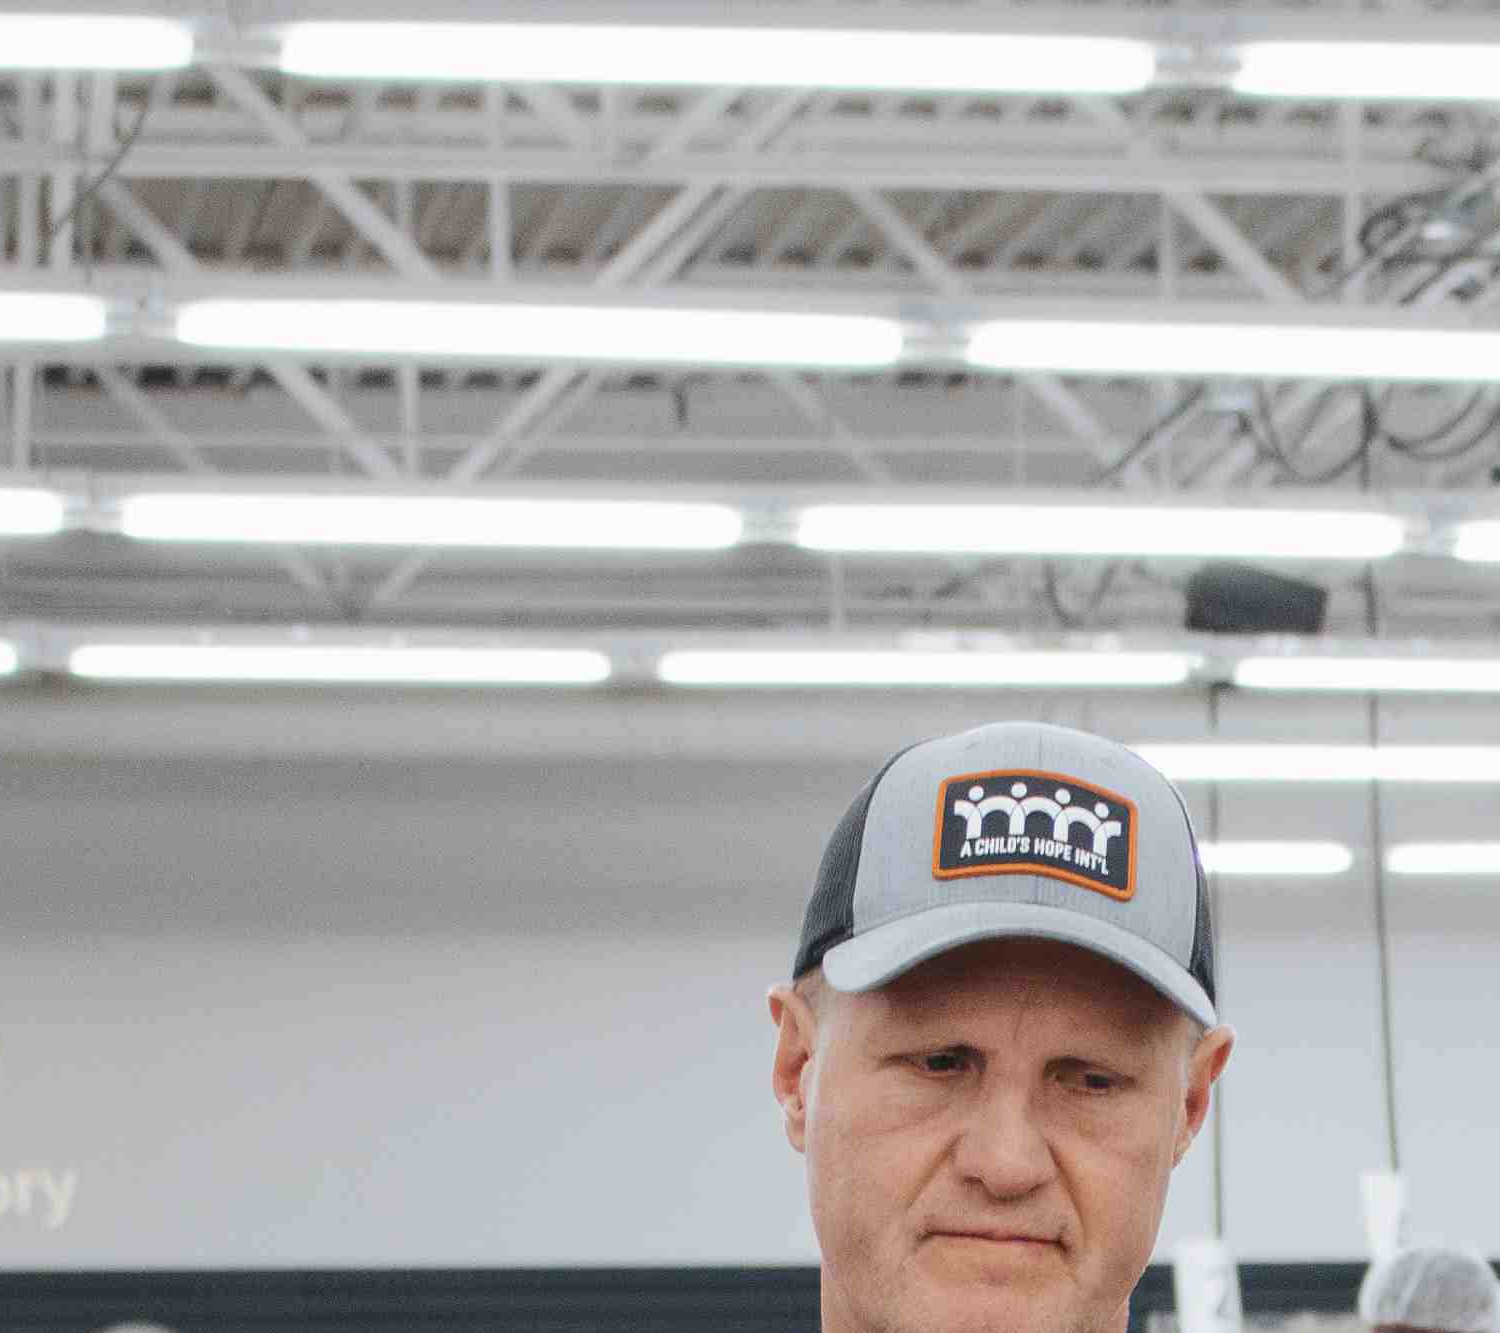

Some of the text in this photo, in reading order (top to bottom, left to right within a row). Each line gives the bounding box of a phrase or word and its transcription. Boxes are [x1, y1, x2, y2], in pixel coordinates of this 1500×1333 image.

[960, 836, 1110, 876] A CHILD'S HOPE INT'L
